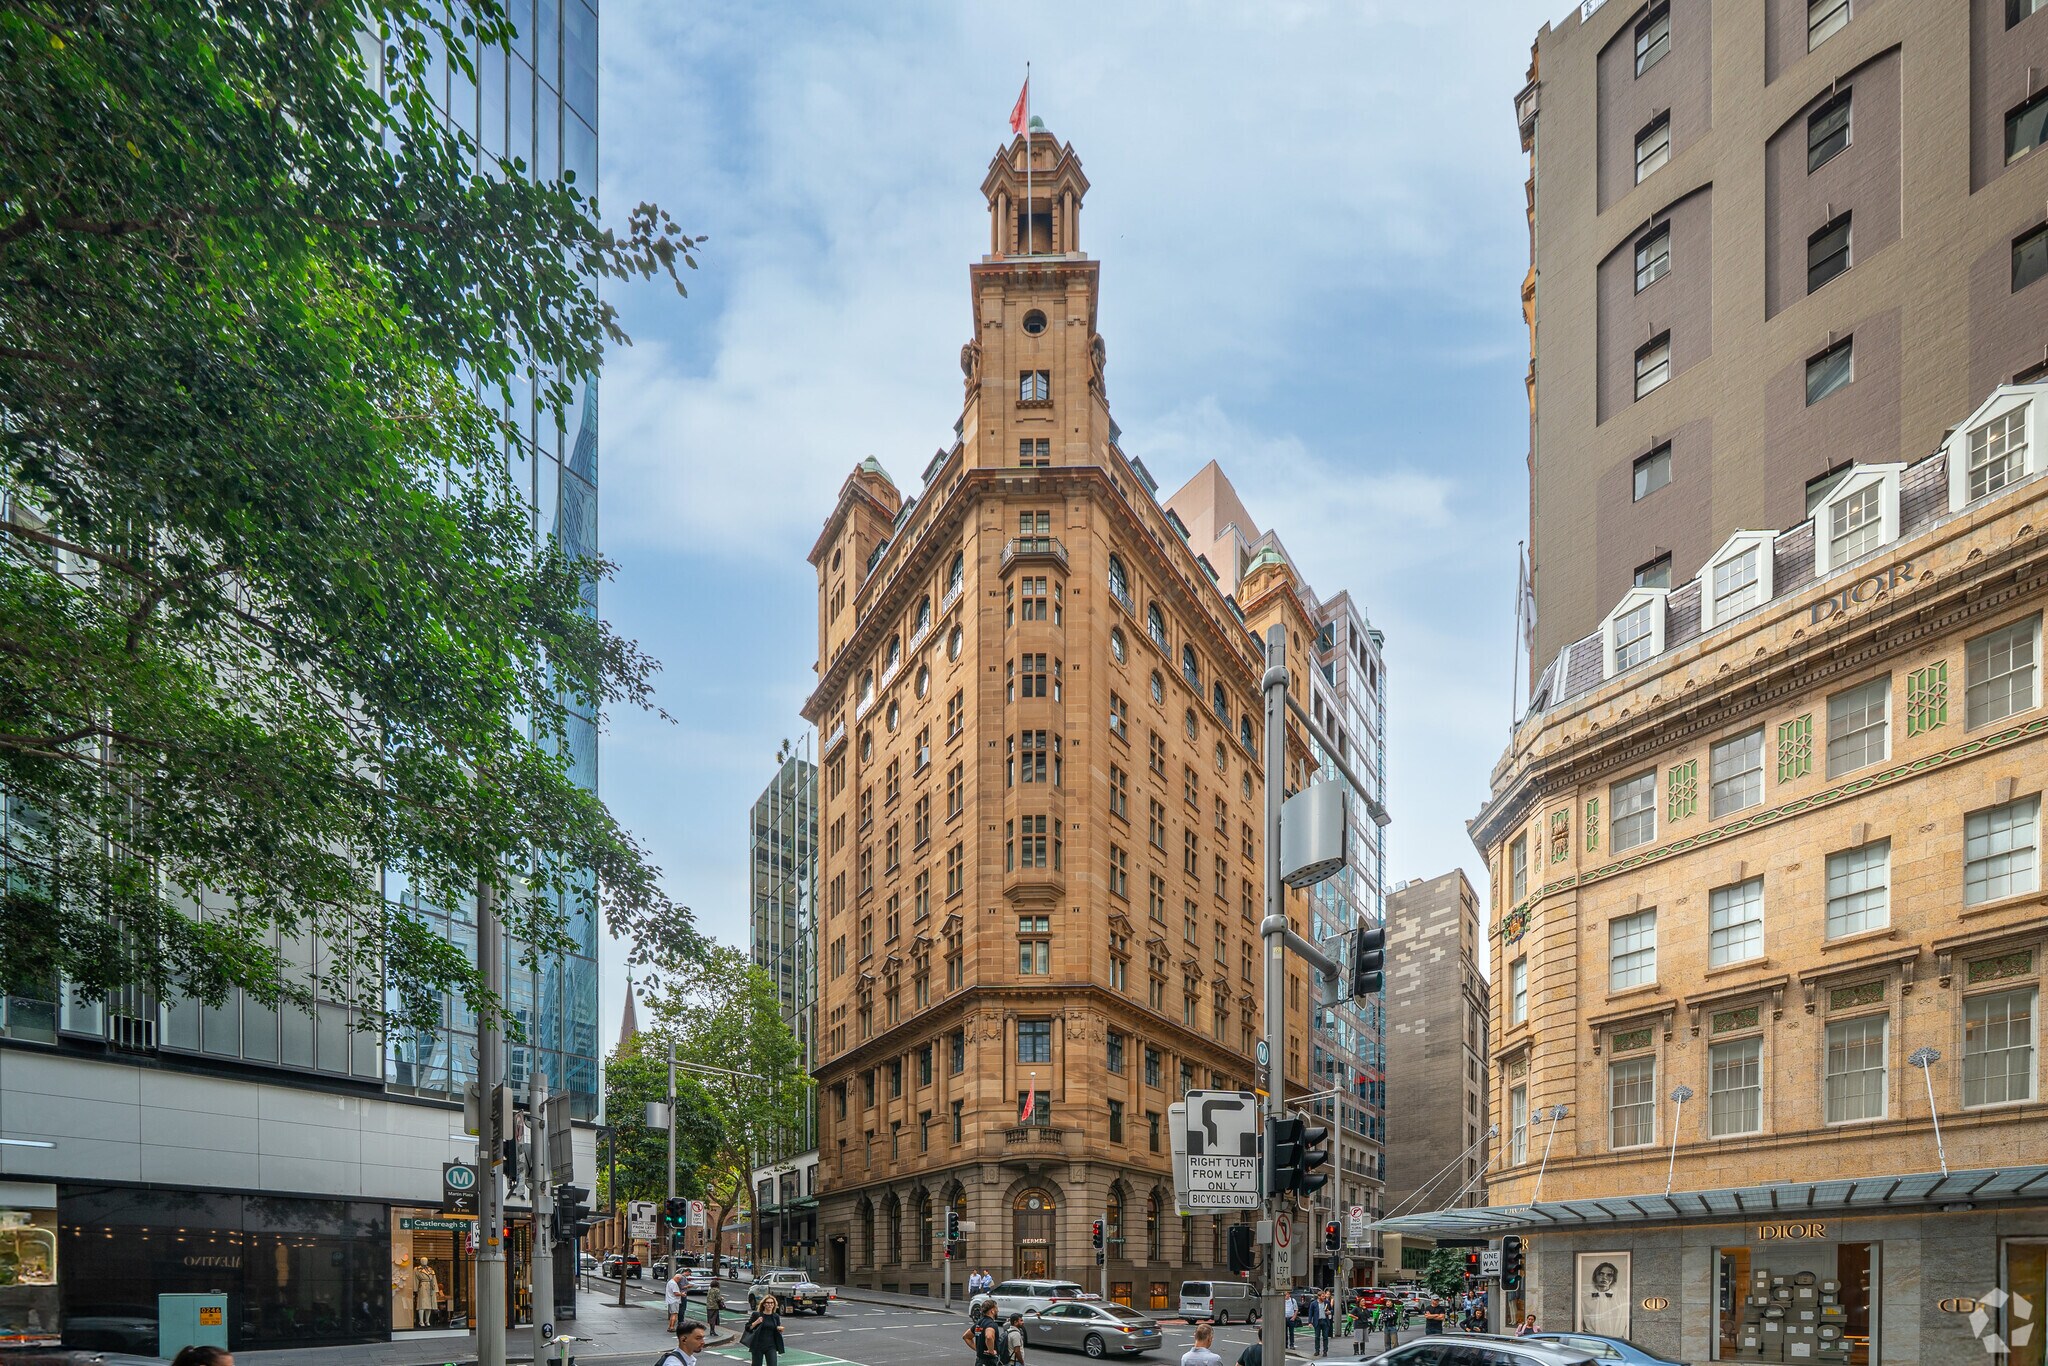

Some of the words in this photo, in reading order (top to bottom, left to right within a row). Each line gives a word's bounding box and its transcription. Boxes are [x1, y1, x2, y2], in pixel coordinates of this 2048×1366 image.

[1811, 562, 1914, 625] DIOR
[1190, 1158, 1221, 1166] RIGHT
[1225, 1159, 1254, 1168] TURN
[453, 1171, 468, 1184] M
[986, 1167, 997, 1181] 19
[1072, 1166, 1084, 1180] 14
[1193, 1170, 1223, 1179] FROM
[1226, 1171, 1252, 1180] LEFT
[1208, 1182, 1238, 1191] ONLY
[1193, 1195, 1231, 1204] BICYCLES
[1233, 1196, 1255, 1205] ONLY
[414, 1219, 458, 1229] Castlereagh
[1758, 1223, 1828, 1241] DIOR
[1277, 1251, 1288, 1263] NO
[1276, 1266, 1289, 1275] LEFT
